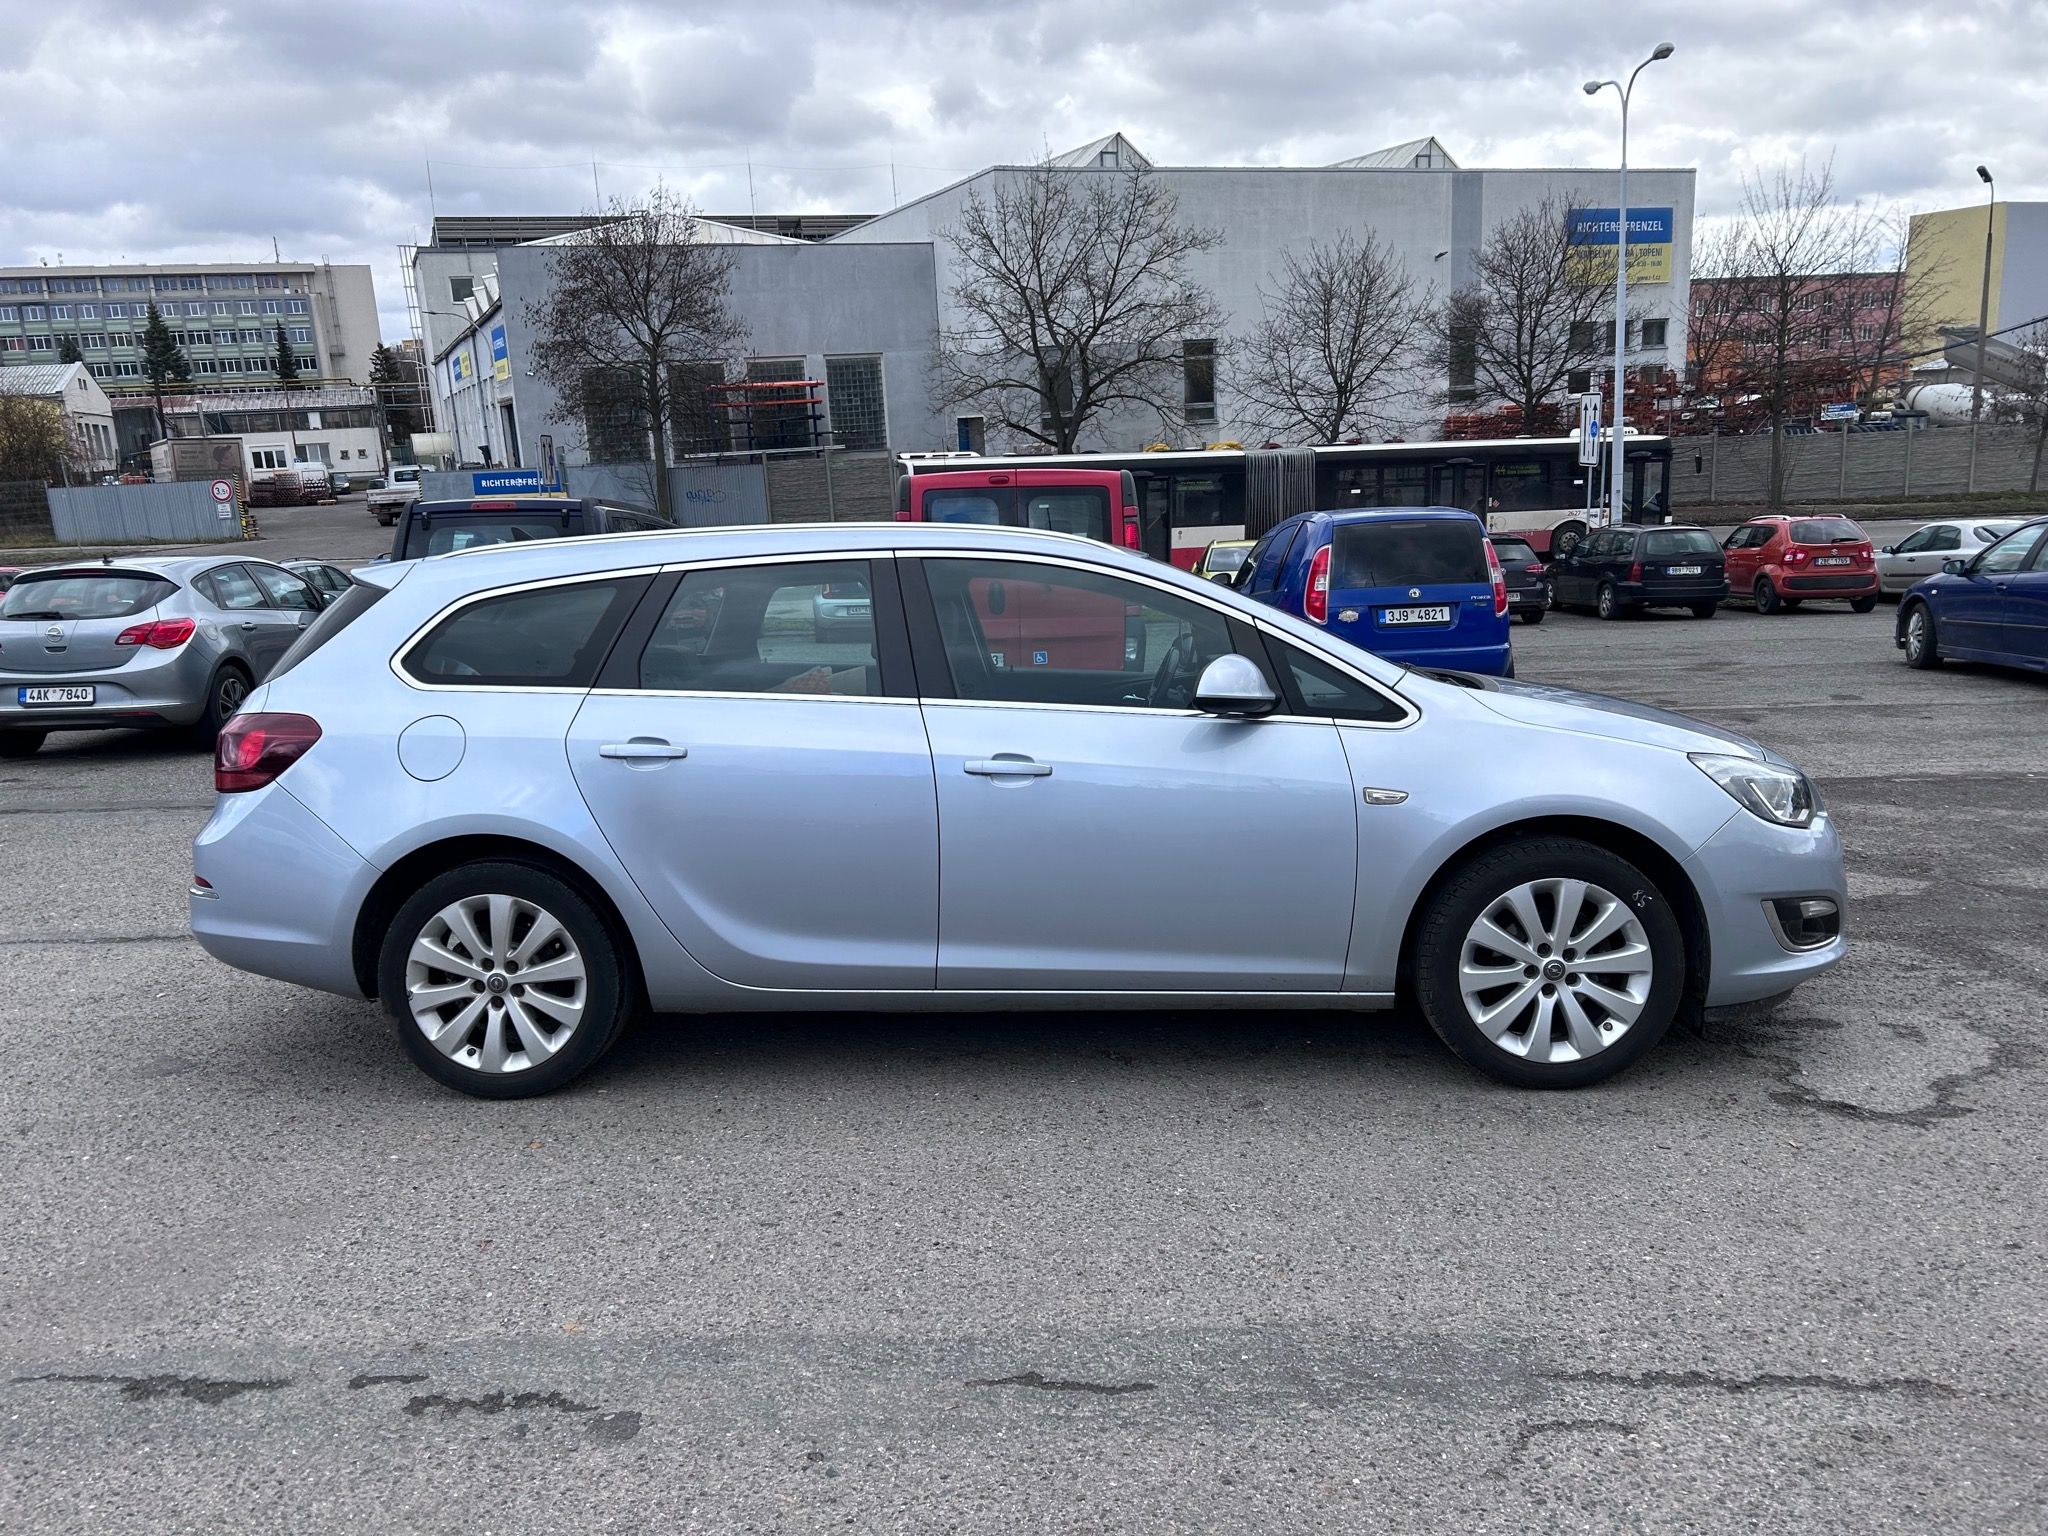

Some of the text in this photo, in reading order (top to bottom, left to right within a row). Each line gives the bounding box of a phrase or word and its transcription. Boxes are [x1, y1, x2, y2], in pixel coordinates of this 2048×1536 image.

[1388, 610, 1409, 622] 3J9
[1417, 608, 1444, 621] 4821
[29, 688, 88, 701] 4AK 7840
